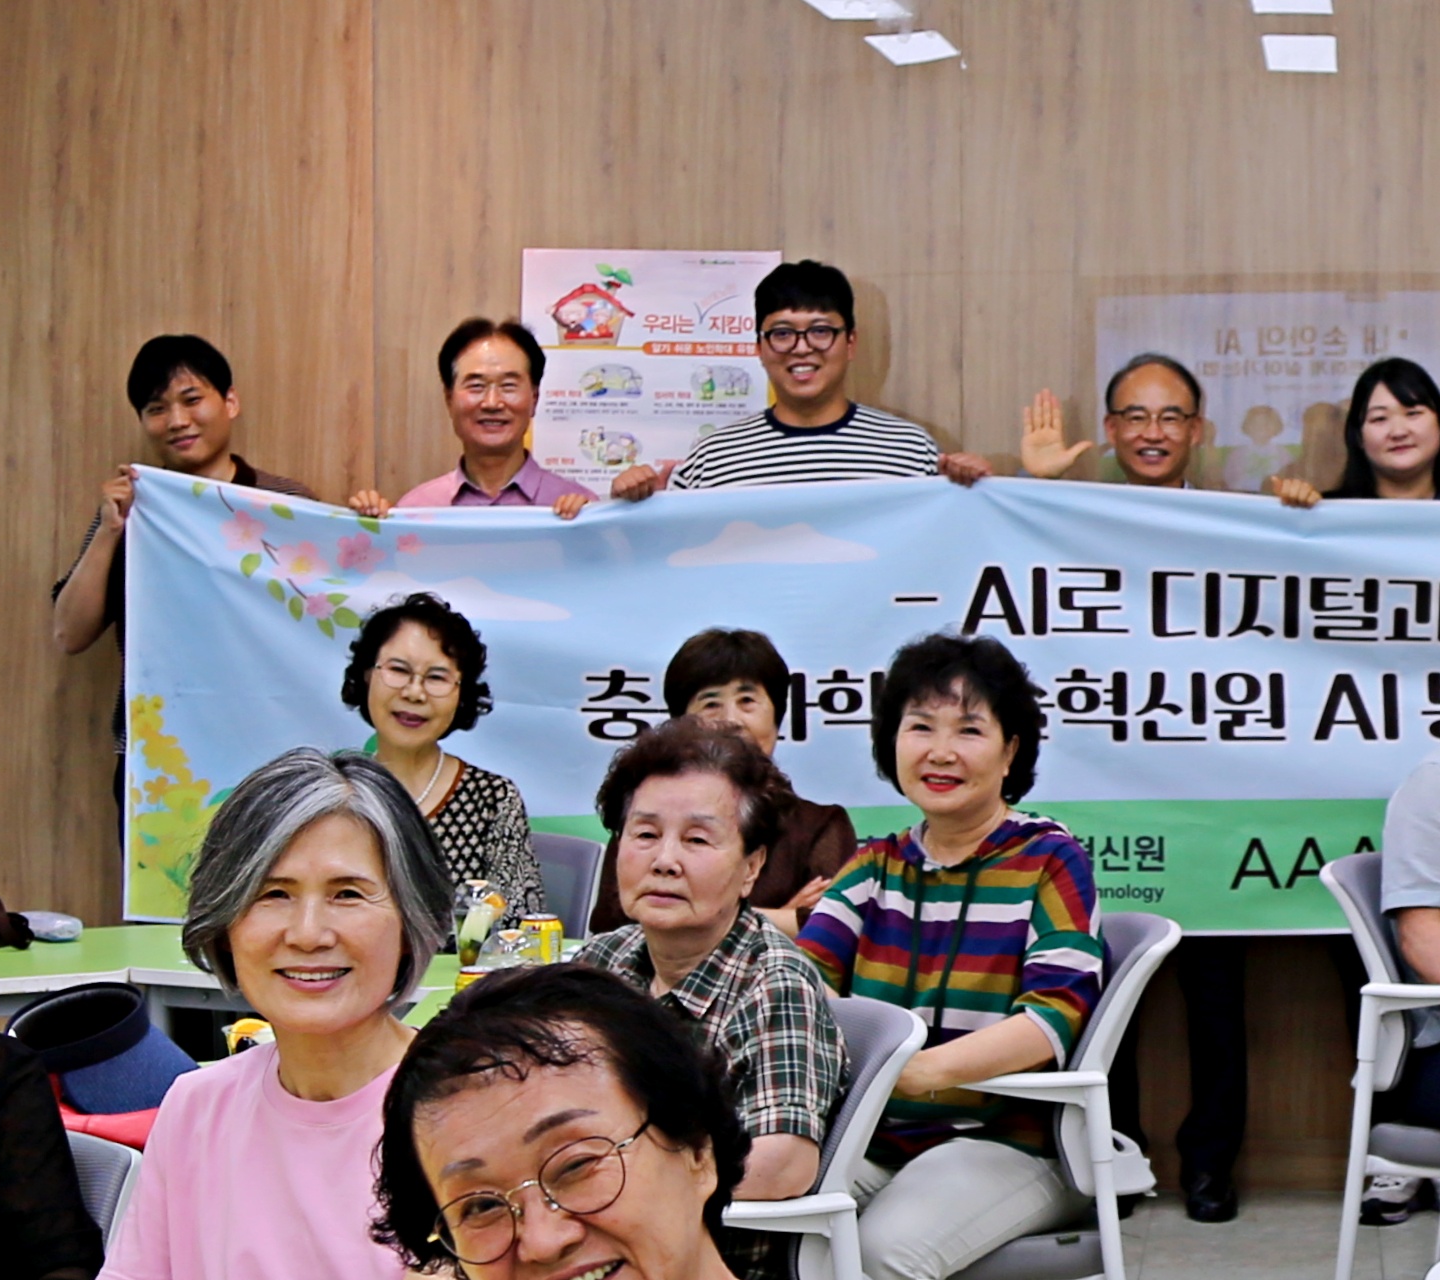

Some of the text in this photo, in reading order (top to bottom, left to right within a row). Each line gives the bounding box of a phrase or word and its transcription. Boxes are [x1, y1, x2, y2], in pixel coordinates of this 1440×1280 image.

[642, 313, 695, 334] 우리는
[961, 565, 1130, 636] AI로
[1313, 672, 1400, 741] AI
